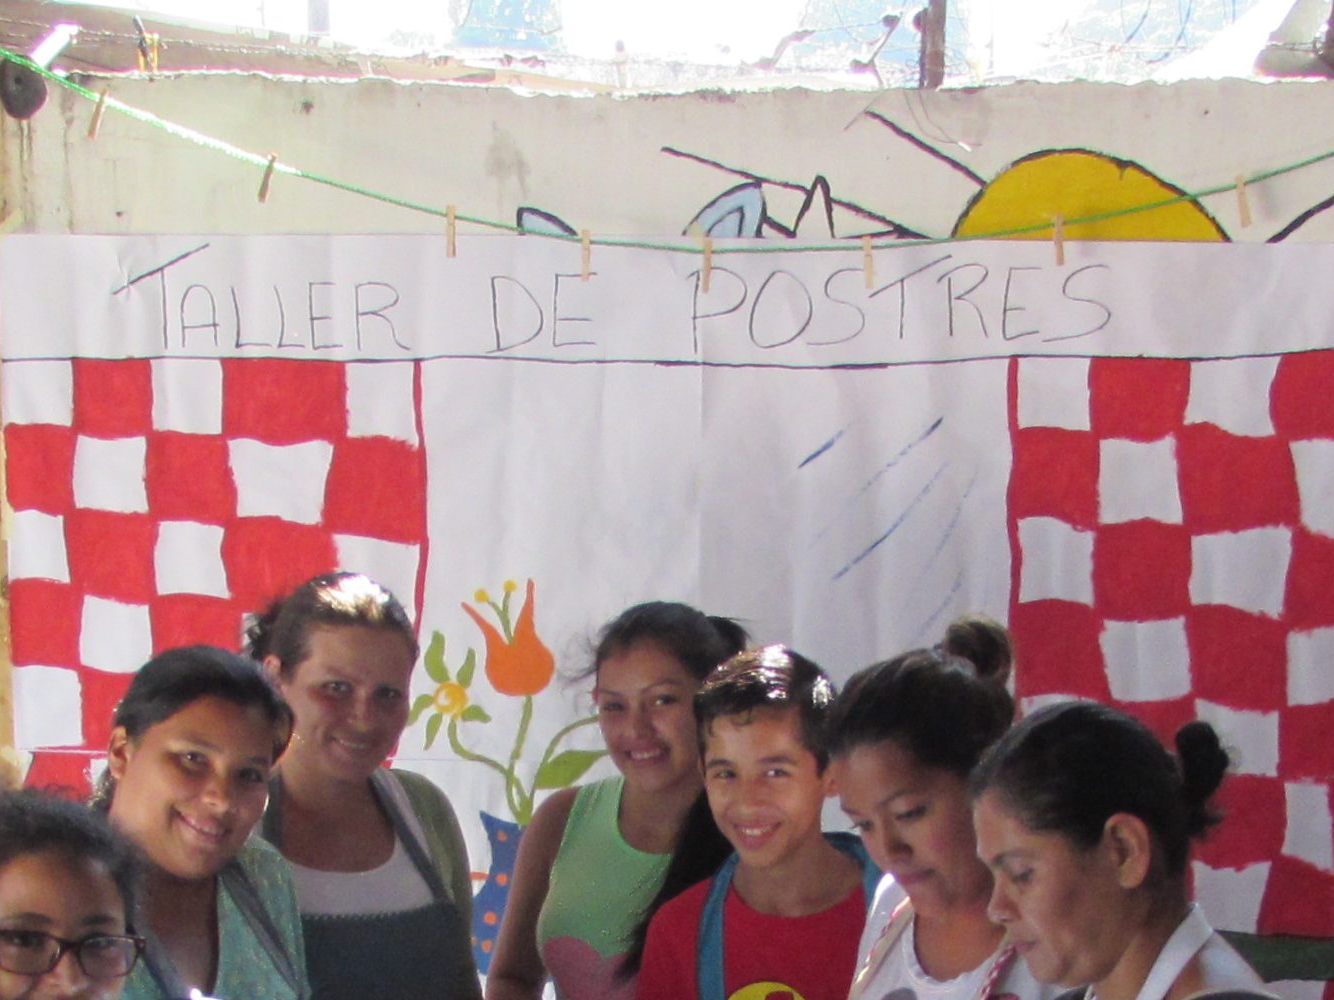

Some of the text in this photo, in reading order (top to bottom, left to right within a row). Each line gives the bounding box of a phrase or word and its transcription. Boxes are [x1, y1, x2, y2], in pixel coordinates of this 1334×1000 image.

[113, 242, 1111, 354] TALLER DE POSTRES
